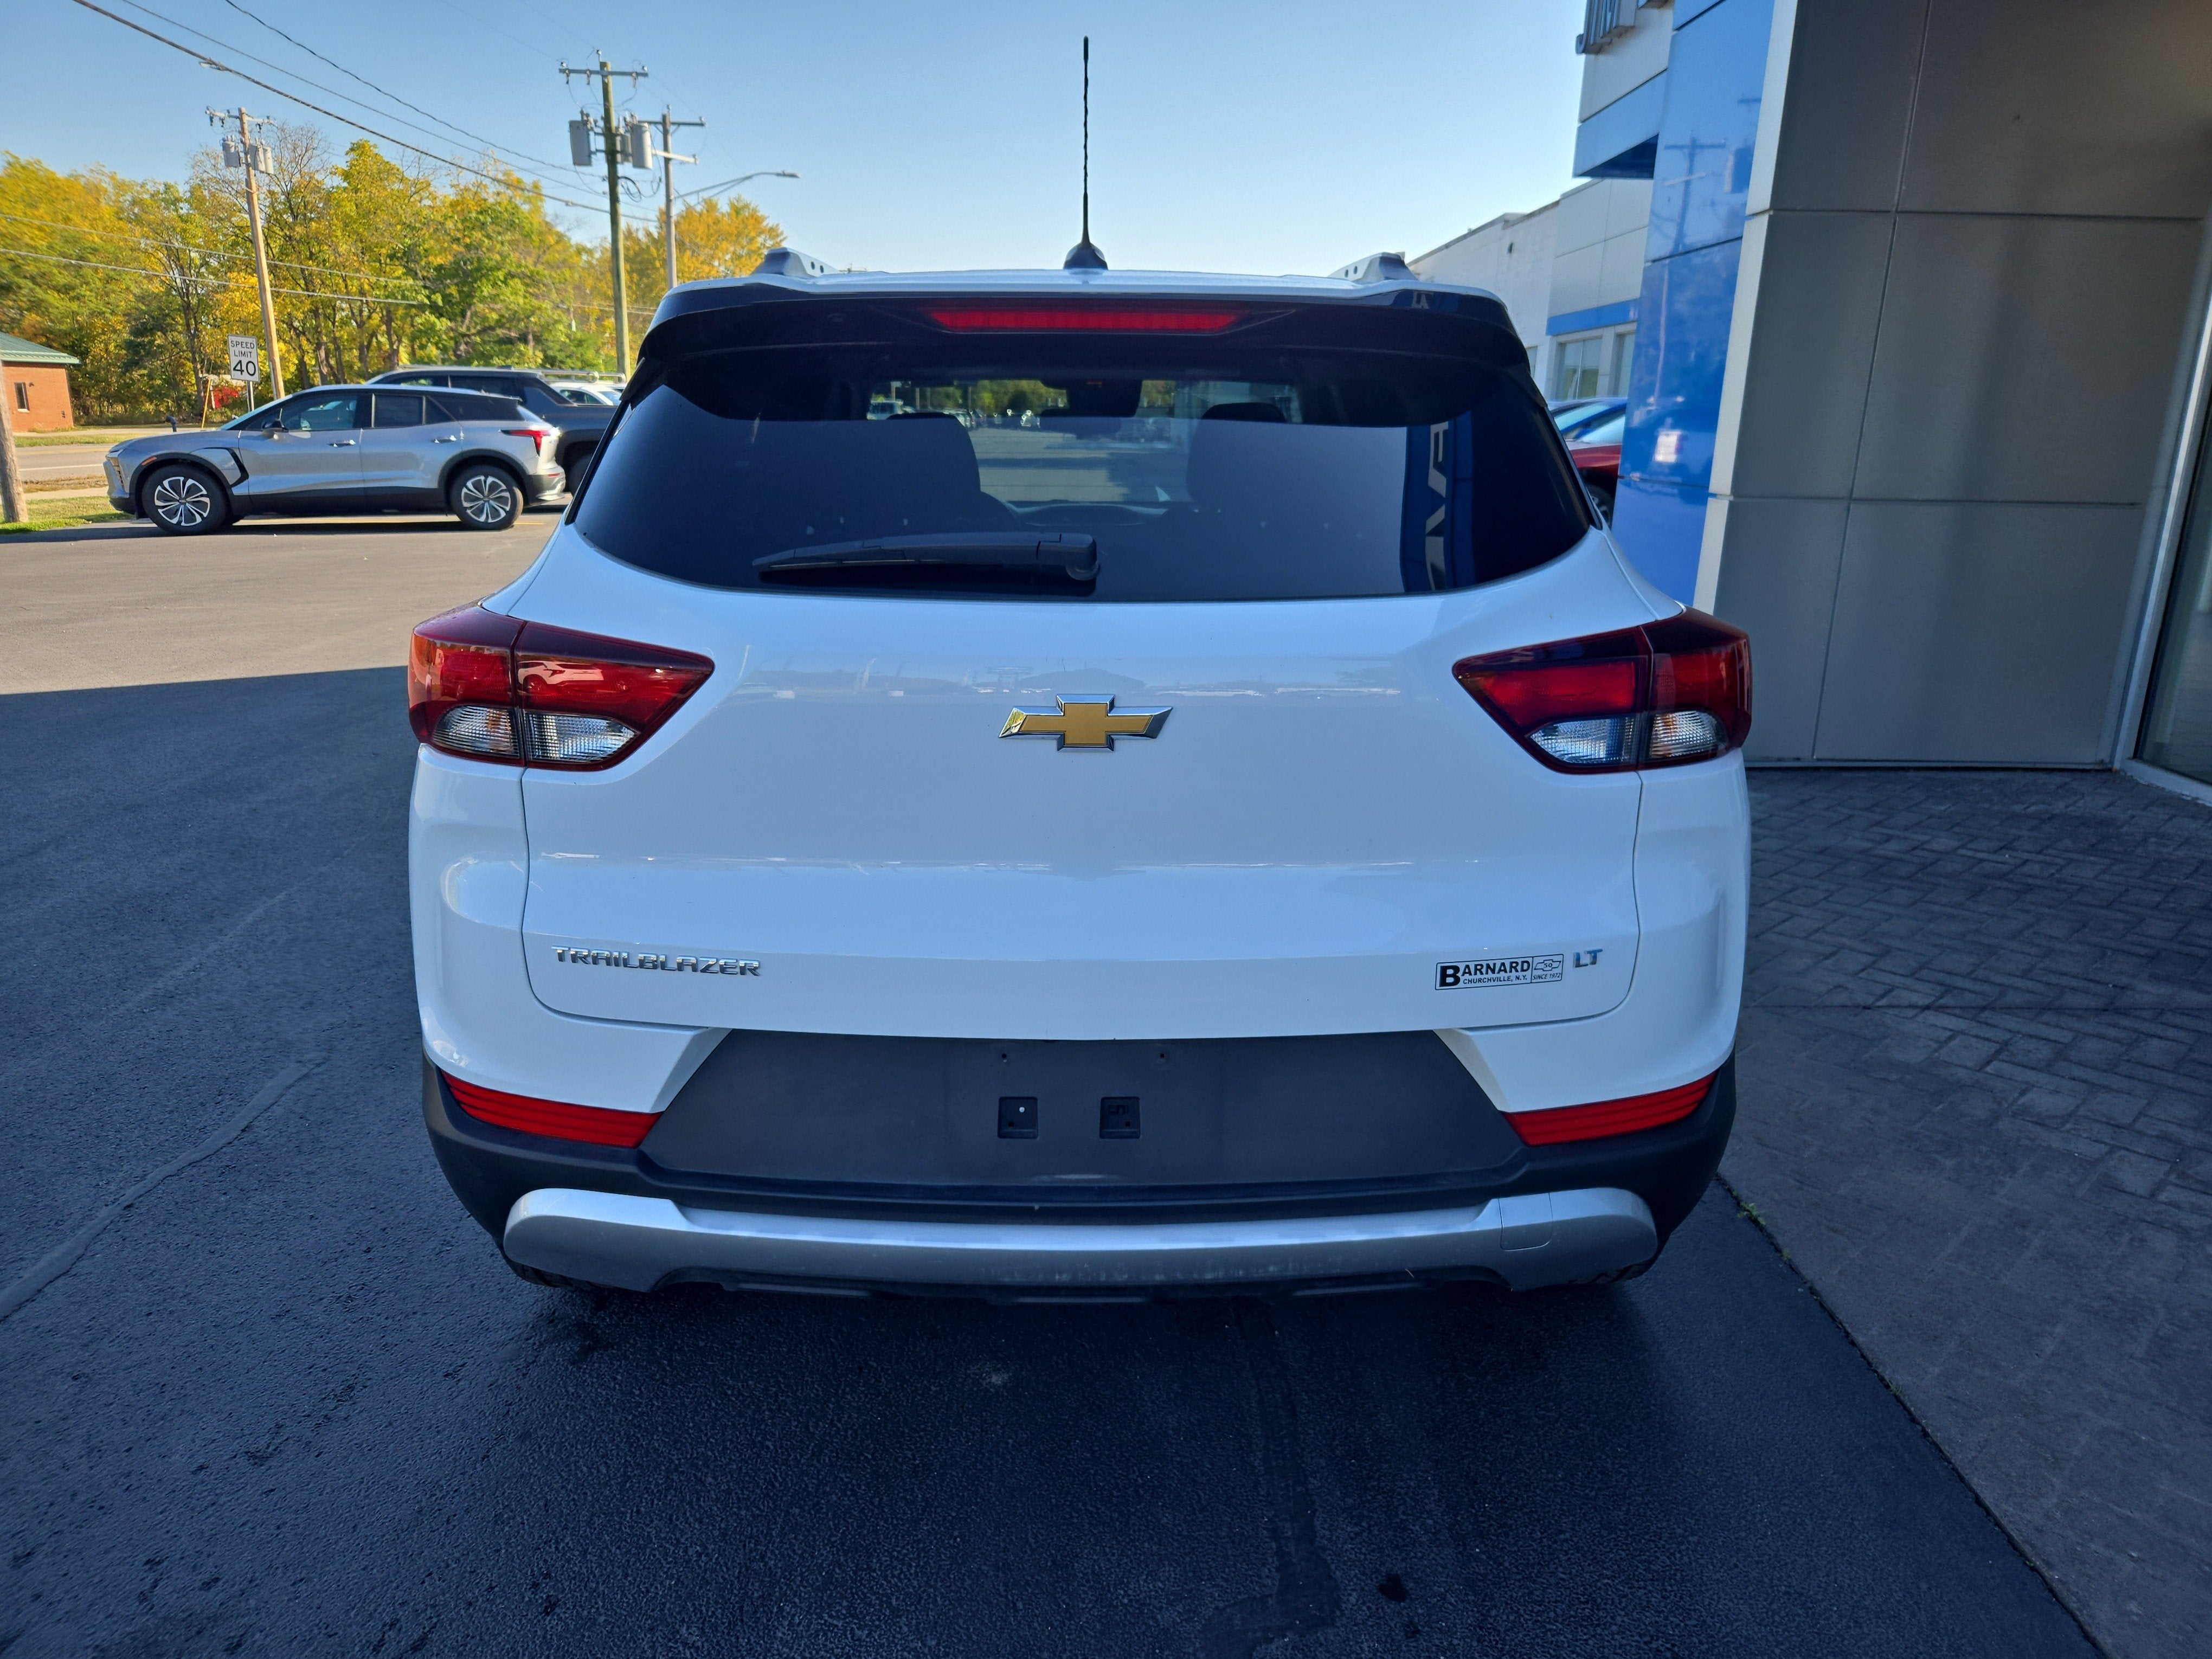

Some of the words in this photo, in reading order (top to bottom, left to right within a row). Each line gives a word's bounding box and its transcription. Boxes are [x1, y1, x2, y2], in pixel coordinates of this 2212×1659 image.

[230, 340, 255, 350] SPEED
[234, 350, 253, 358] LIMIT
[233, 359, 256, 376] 40
[551, 945, 761, 976] TRAILBLAZER
[1573, 948, 1603, 968] LT
[1439, 960, 1531, 987] BARNARD
[1463, 975, 1513, 985] CHURCHVILLE,
